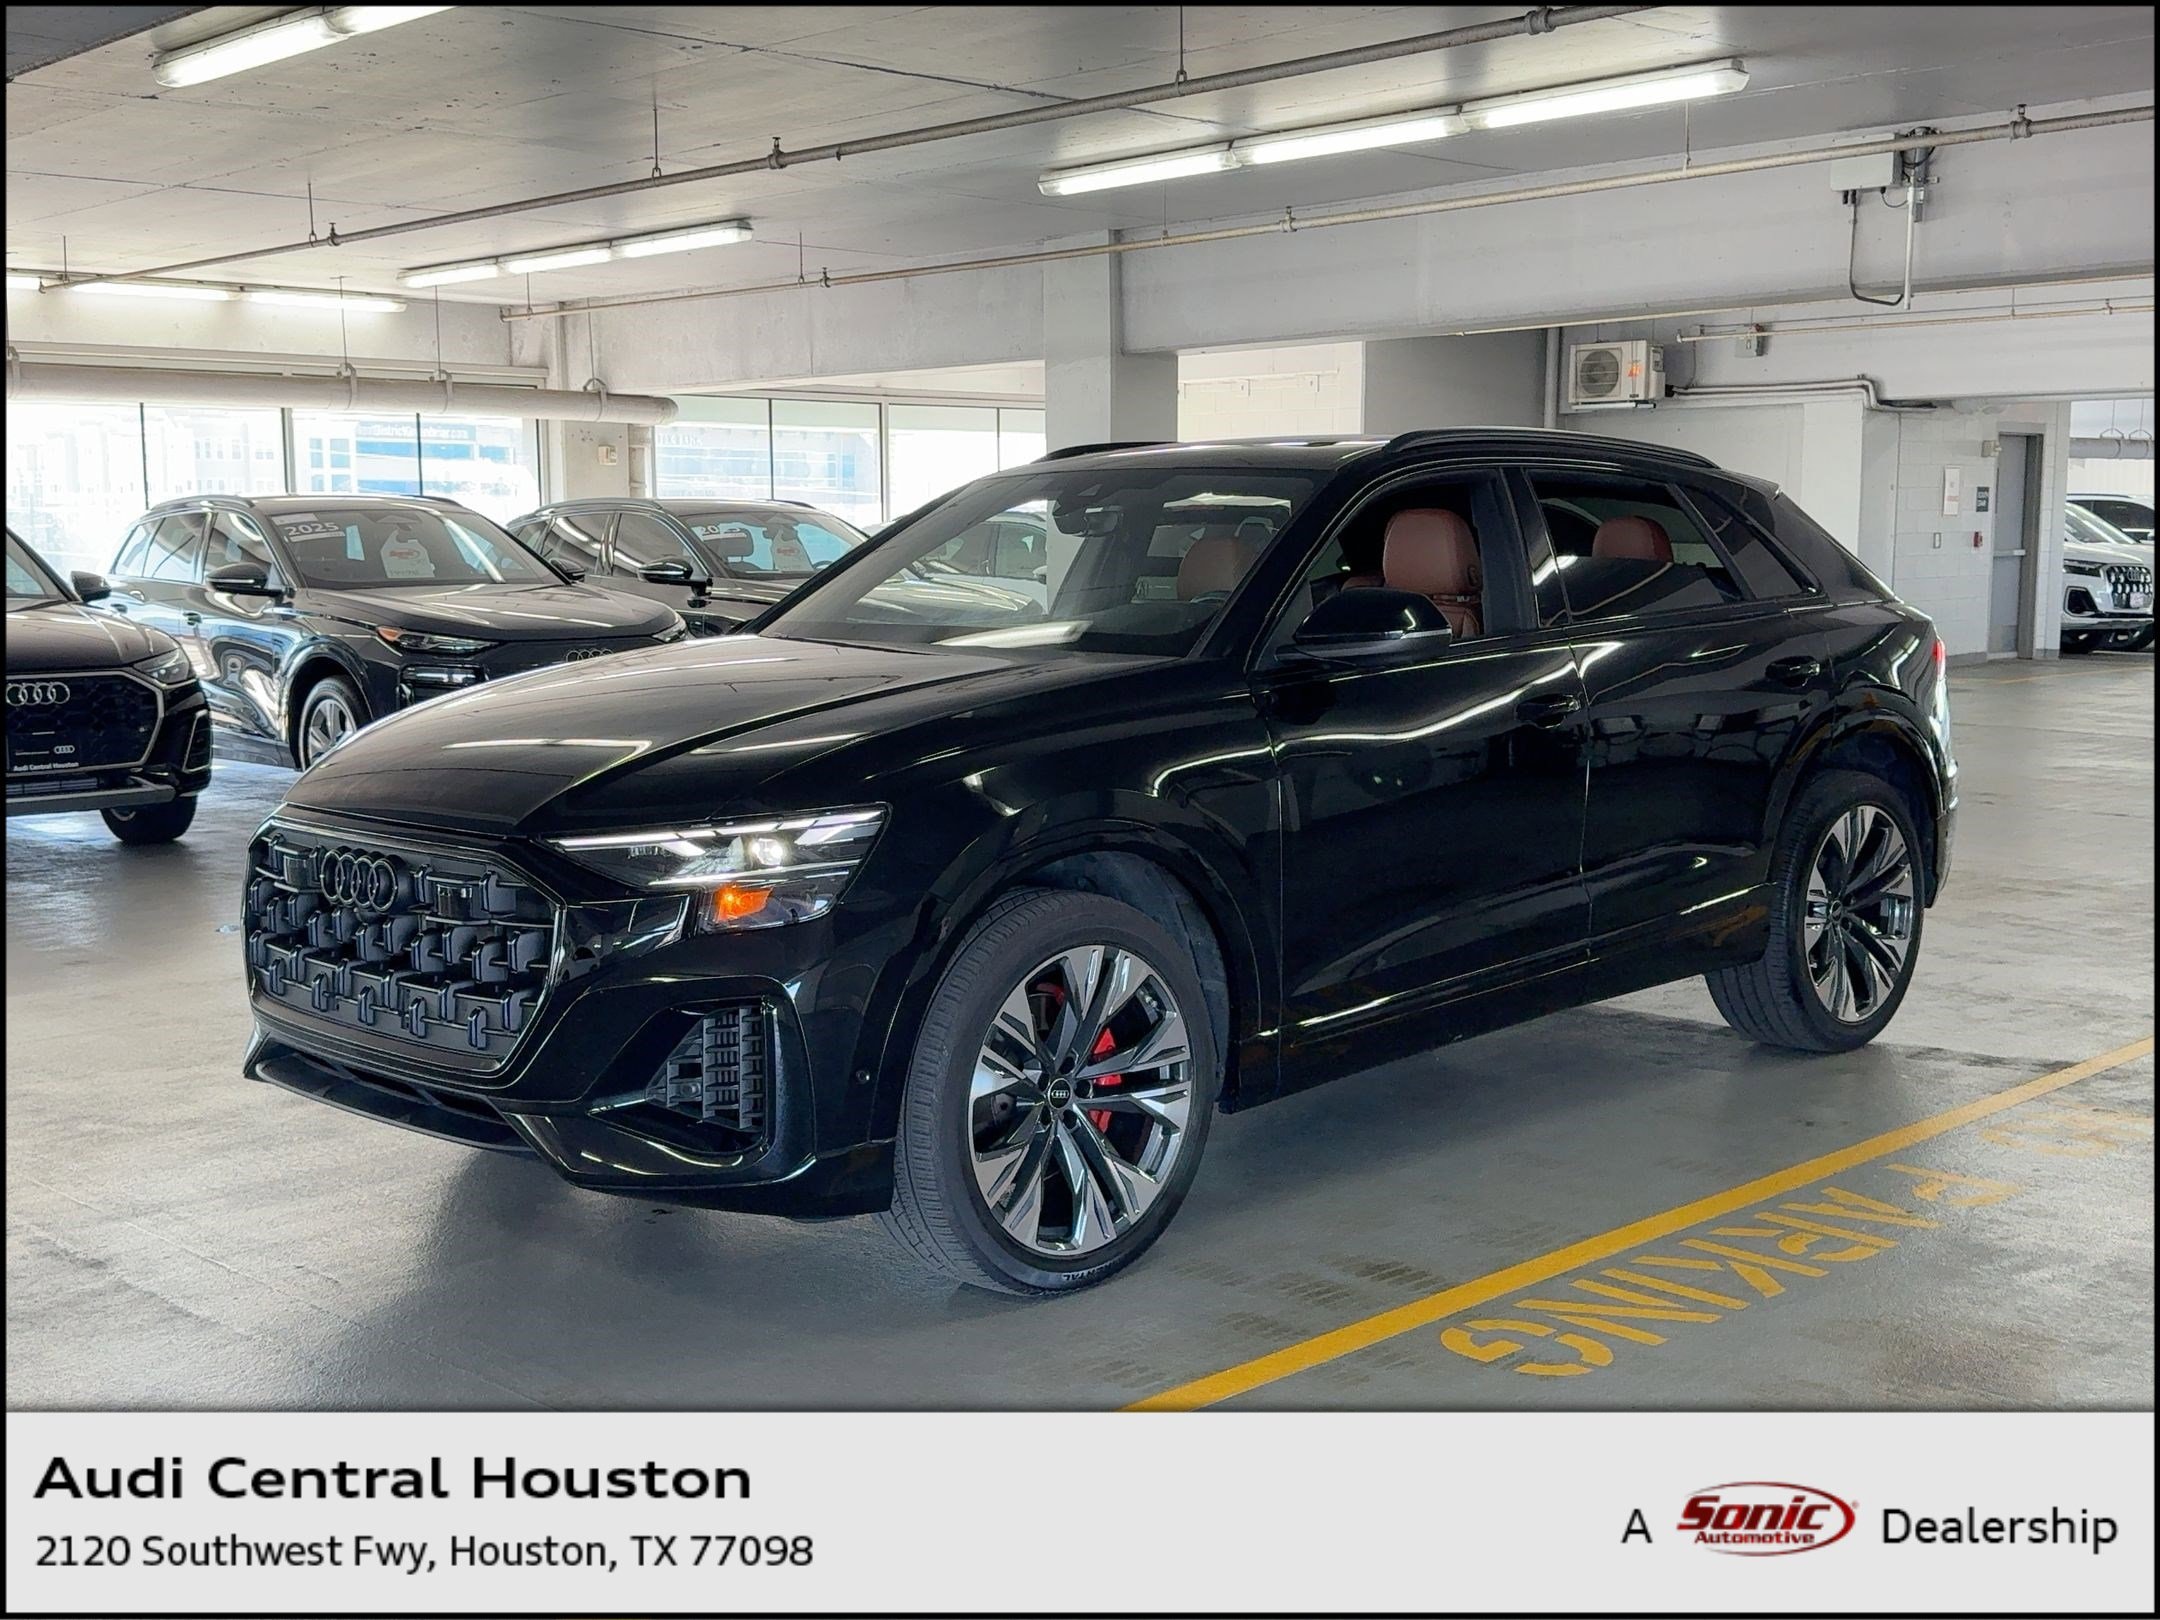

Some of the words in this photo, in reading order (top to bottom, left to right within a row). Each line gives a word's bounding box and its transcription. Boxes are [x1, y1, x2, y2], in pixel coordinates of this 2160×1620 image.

[284, 522, 339, 536] 2025
[13, 764, 29, 772] Audi
[29, 762, 52, 771] Central
[53, 761, 79, 769] Houston
[1440, 1164, 2023, 1377] PARKING
